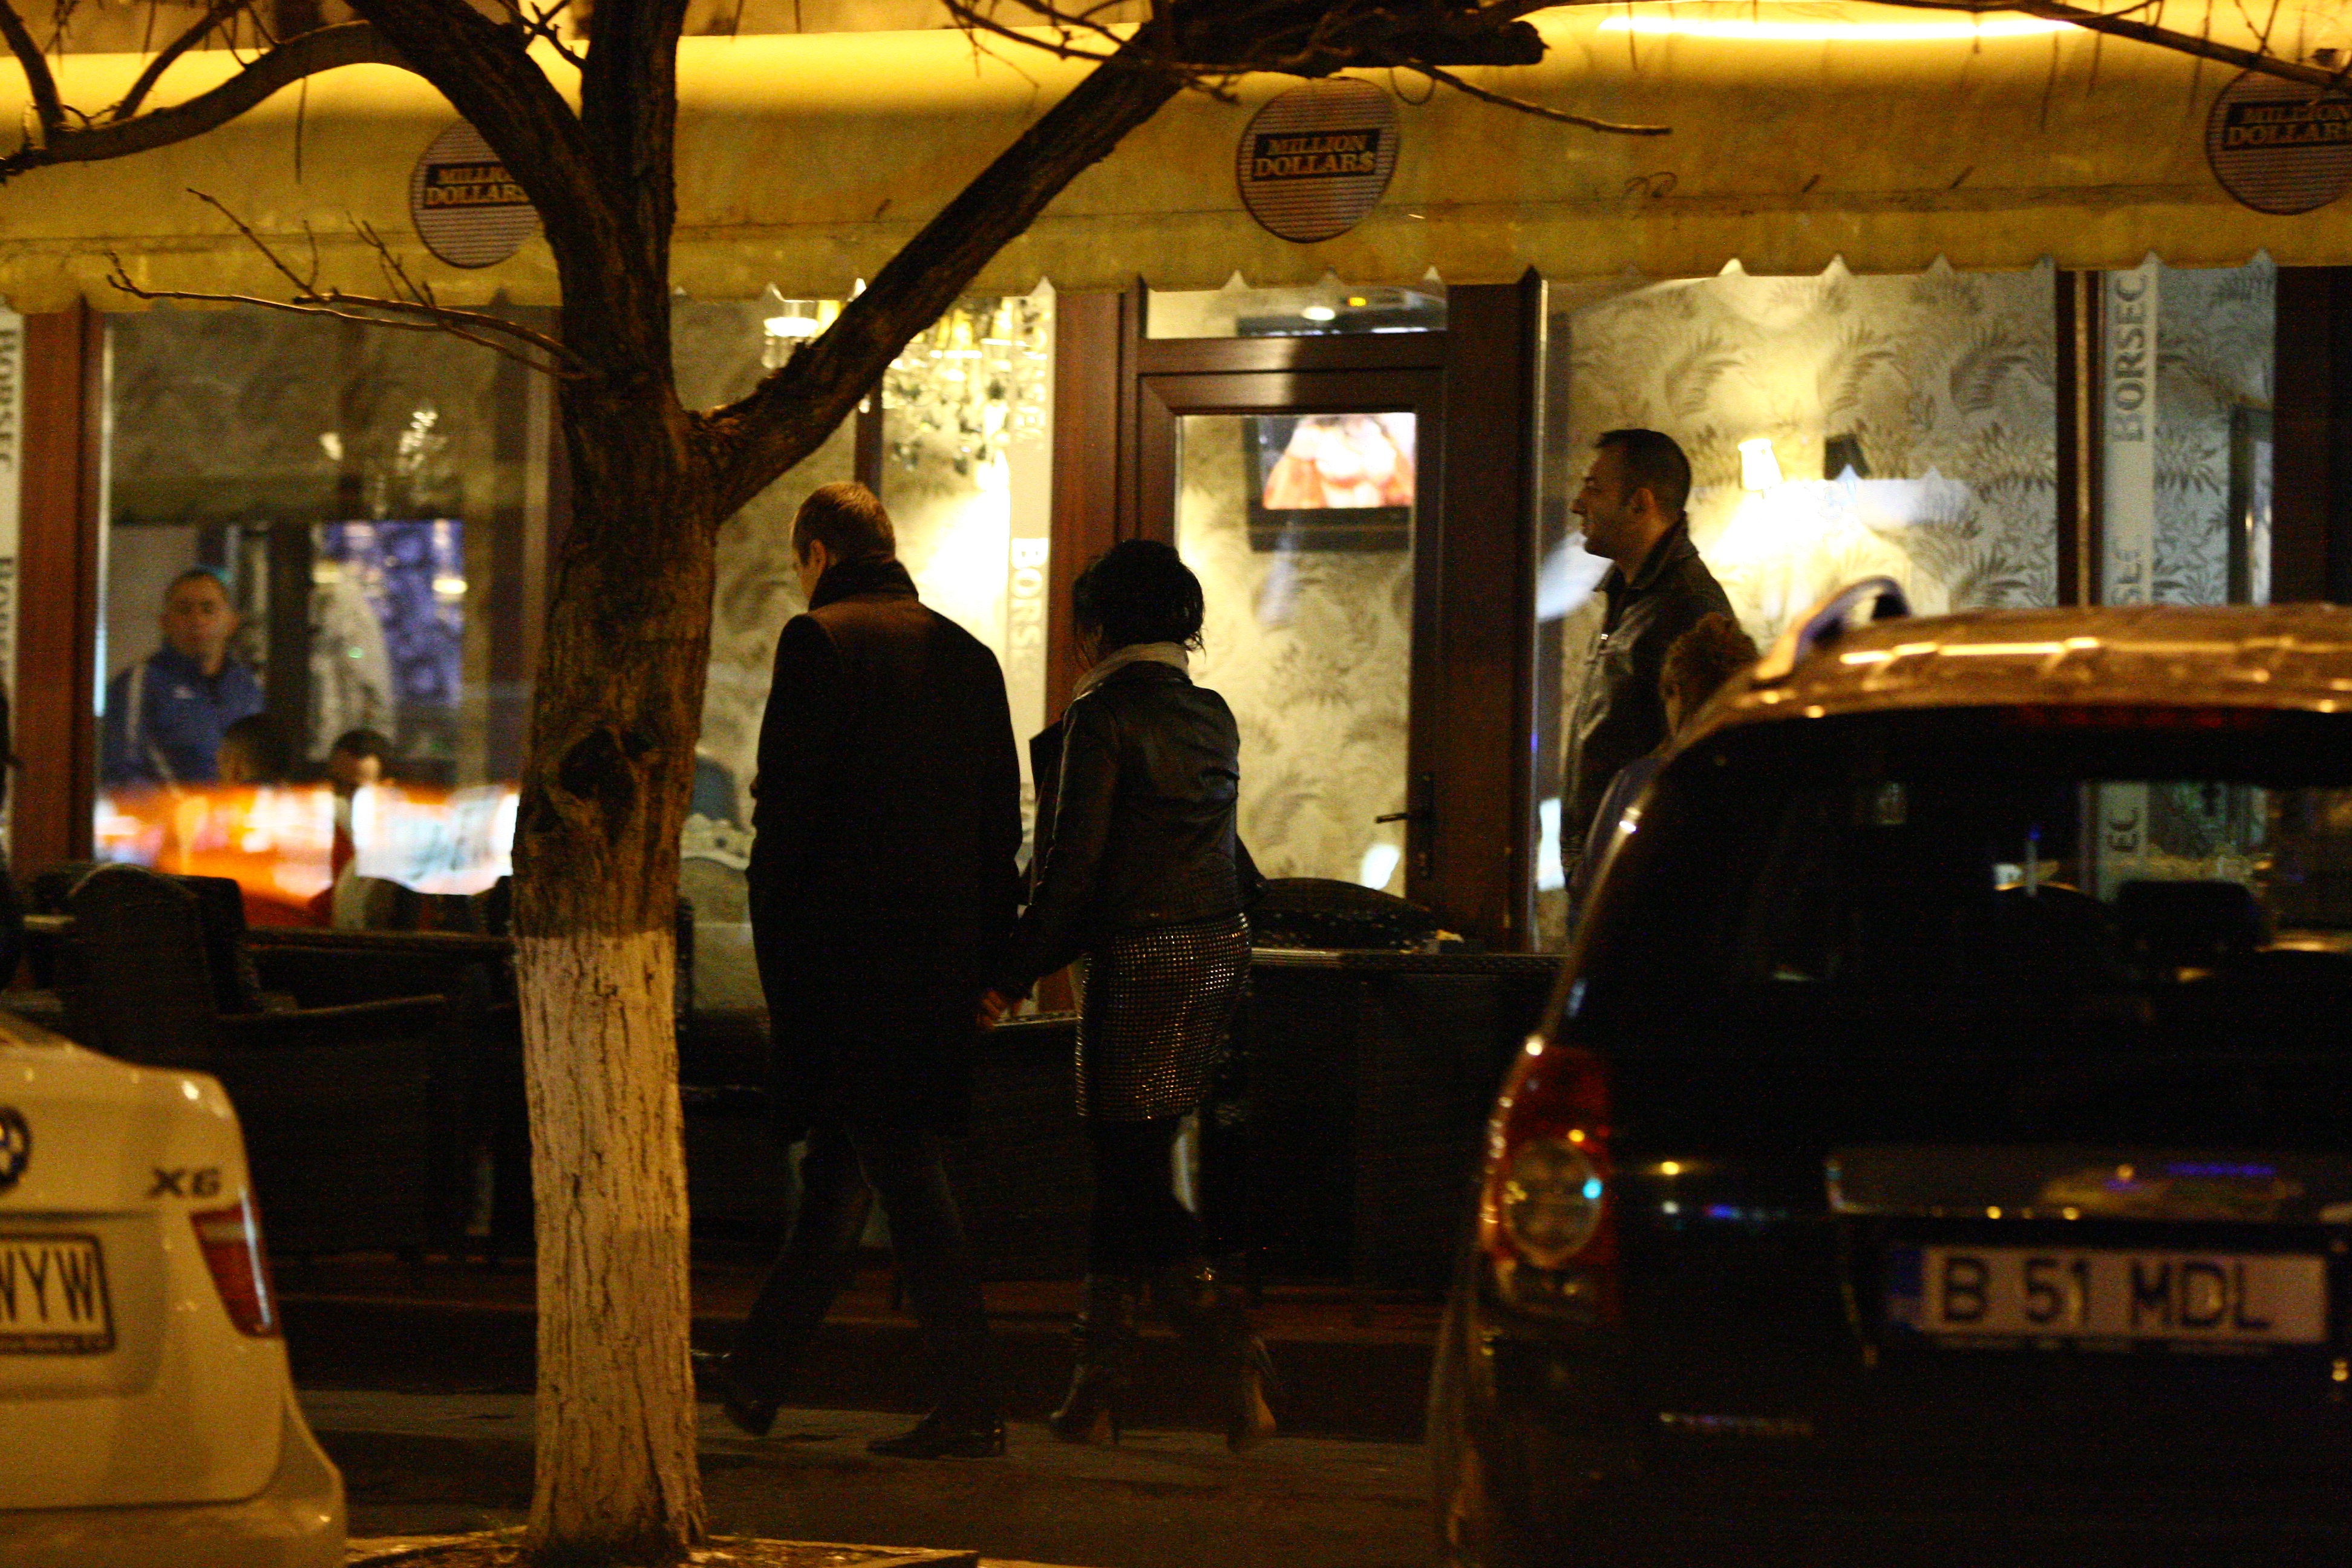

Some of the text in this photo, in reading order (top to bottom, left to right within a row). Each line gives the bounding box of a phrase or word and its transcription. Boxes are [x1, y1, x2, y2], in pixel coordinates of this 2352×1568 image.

[1268, 136, 1367, 154] MILLION
[437, 166, 515, 185] MILLIO
[2113, 273, 2146, 443] BORSEC
[146, 1167, 222, 1198] X6
[1942, 1256, 2273, 1330] B 51 MDL
